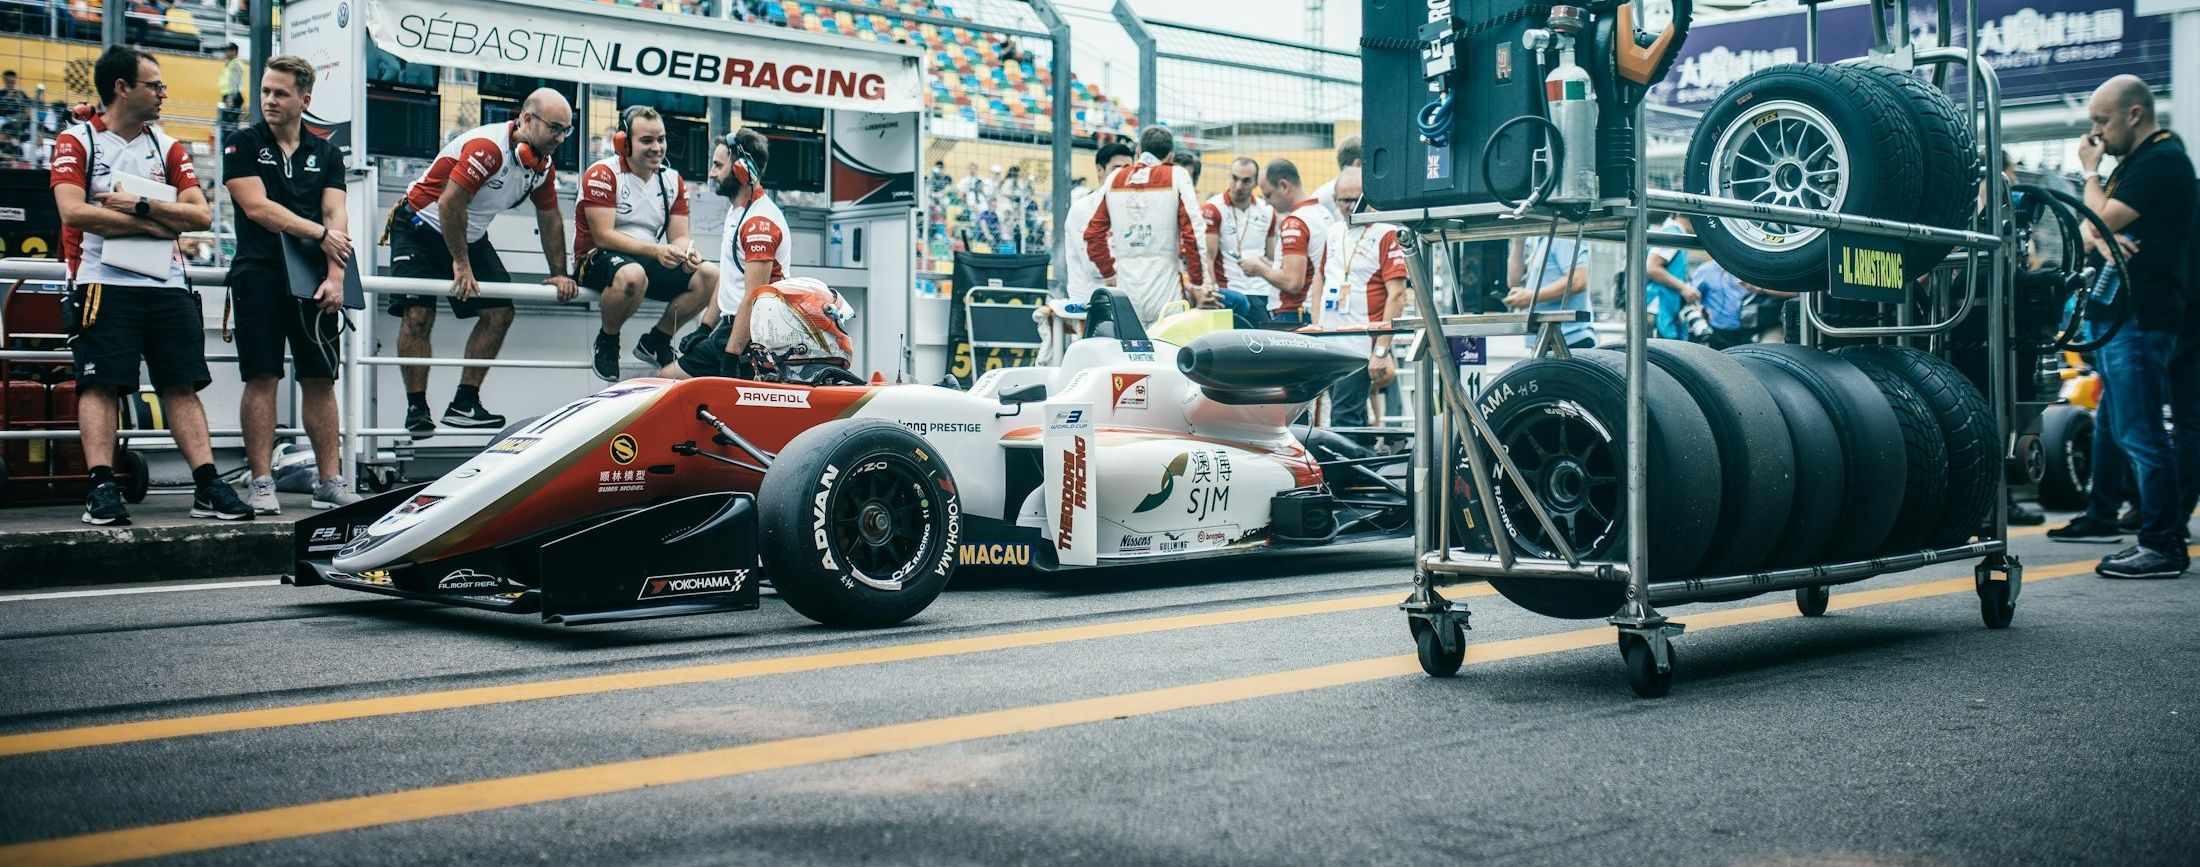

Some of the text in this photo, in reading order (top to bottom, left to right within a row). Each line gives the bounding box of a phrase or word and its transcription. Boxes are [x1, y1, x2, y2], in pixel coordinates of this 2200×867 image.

[1854, 248, 1903, 290] ARMSTRONG
[743, 392, 804, 403] RAVENOL
[929, 423, 982, 432] PRESTIGE
[1052, 410, 1083, 423] F3
[1074, 435, 1087, 510] RACING
[1191, 449, 1232, 483] 澳博
[1058, 449, 1075, 551] THEODORE
[1186, 485, 1230, 521] SJM
[1493, 485, 1518, 539] RACING
[813, 464, 840, 571] ADVAN
[311, 527, 336, 539] F3
[913, 522, 932, 567] RACING
[934, 494, 960, 577] YOKOHAMA
[1120, 534, 1152, 548] Nissens
[1159, 541, 1188, 551] GULLWING
[959, 544, 1030, 565] MACAU
[438, 580, 498, 589] ALMOST REAL
[668, 576, 731, 591] YOKOHAMA
